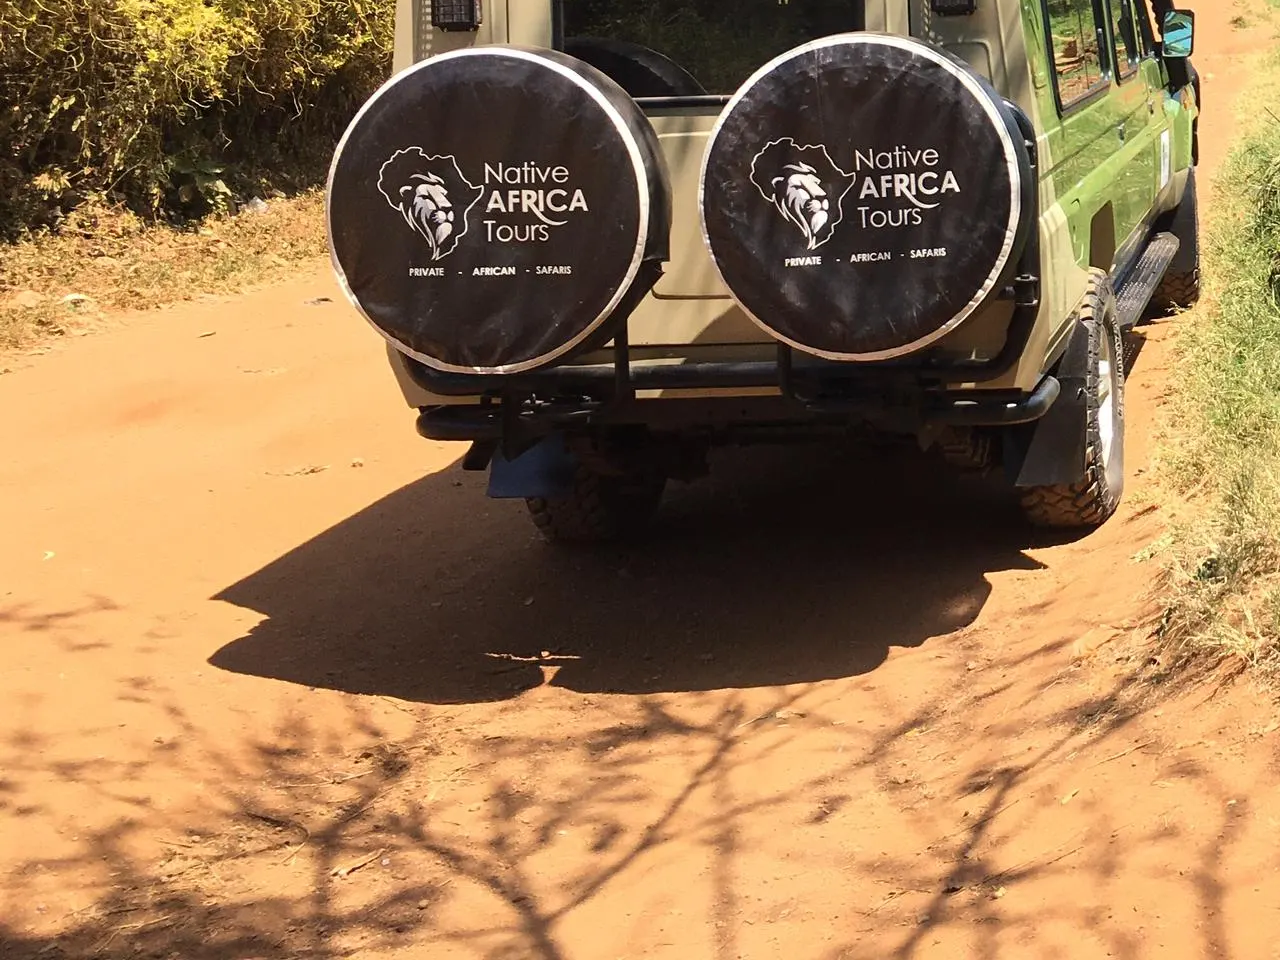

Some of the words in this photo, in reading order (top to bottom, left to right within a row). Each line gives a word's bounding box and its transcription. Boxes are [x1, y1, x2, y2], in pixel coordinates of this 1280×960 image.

[855, 145, 939, 171] Native
[484, 161, 569, 184] Native
[859, 170, 961, 209] AFRICA
[485, 189, 589, 226] AFRICA
[857, 207, 922, 229] Tours
[483, 220, 549, 242] Tours
[785, 256, 822, 267] PRIVATE
[850, 251, 891, 263] AFRICAN
[910, 247, 947, 259] SAFARIS
[409, 267, 445, 277] PRIVATE
[472, 266, 516, 276] AFRICAN
[536, 265, 572, 275] SAFARIS
